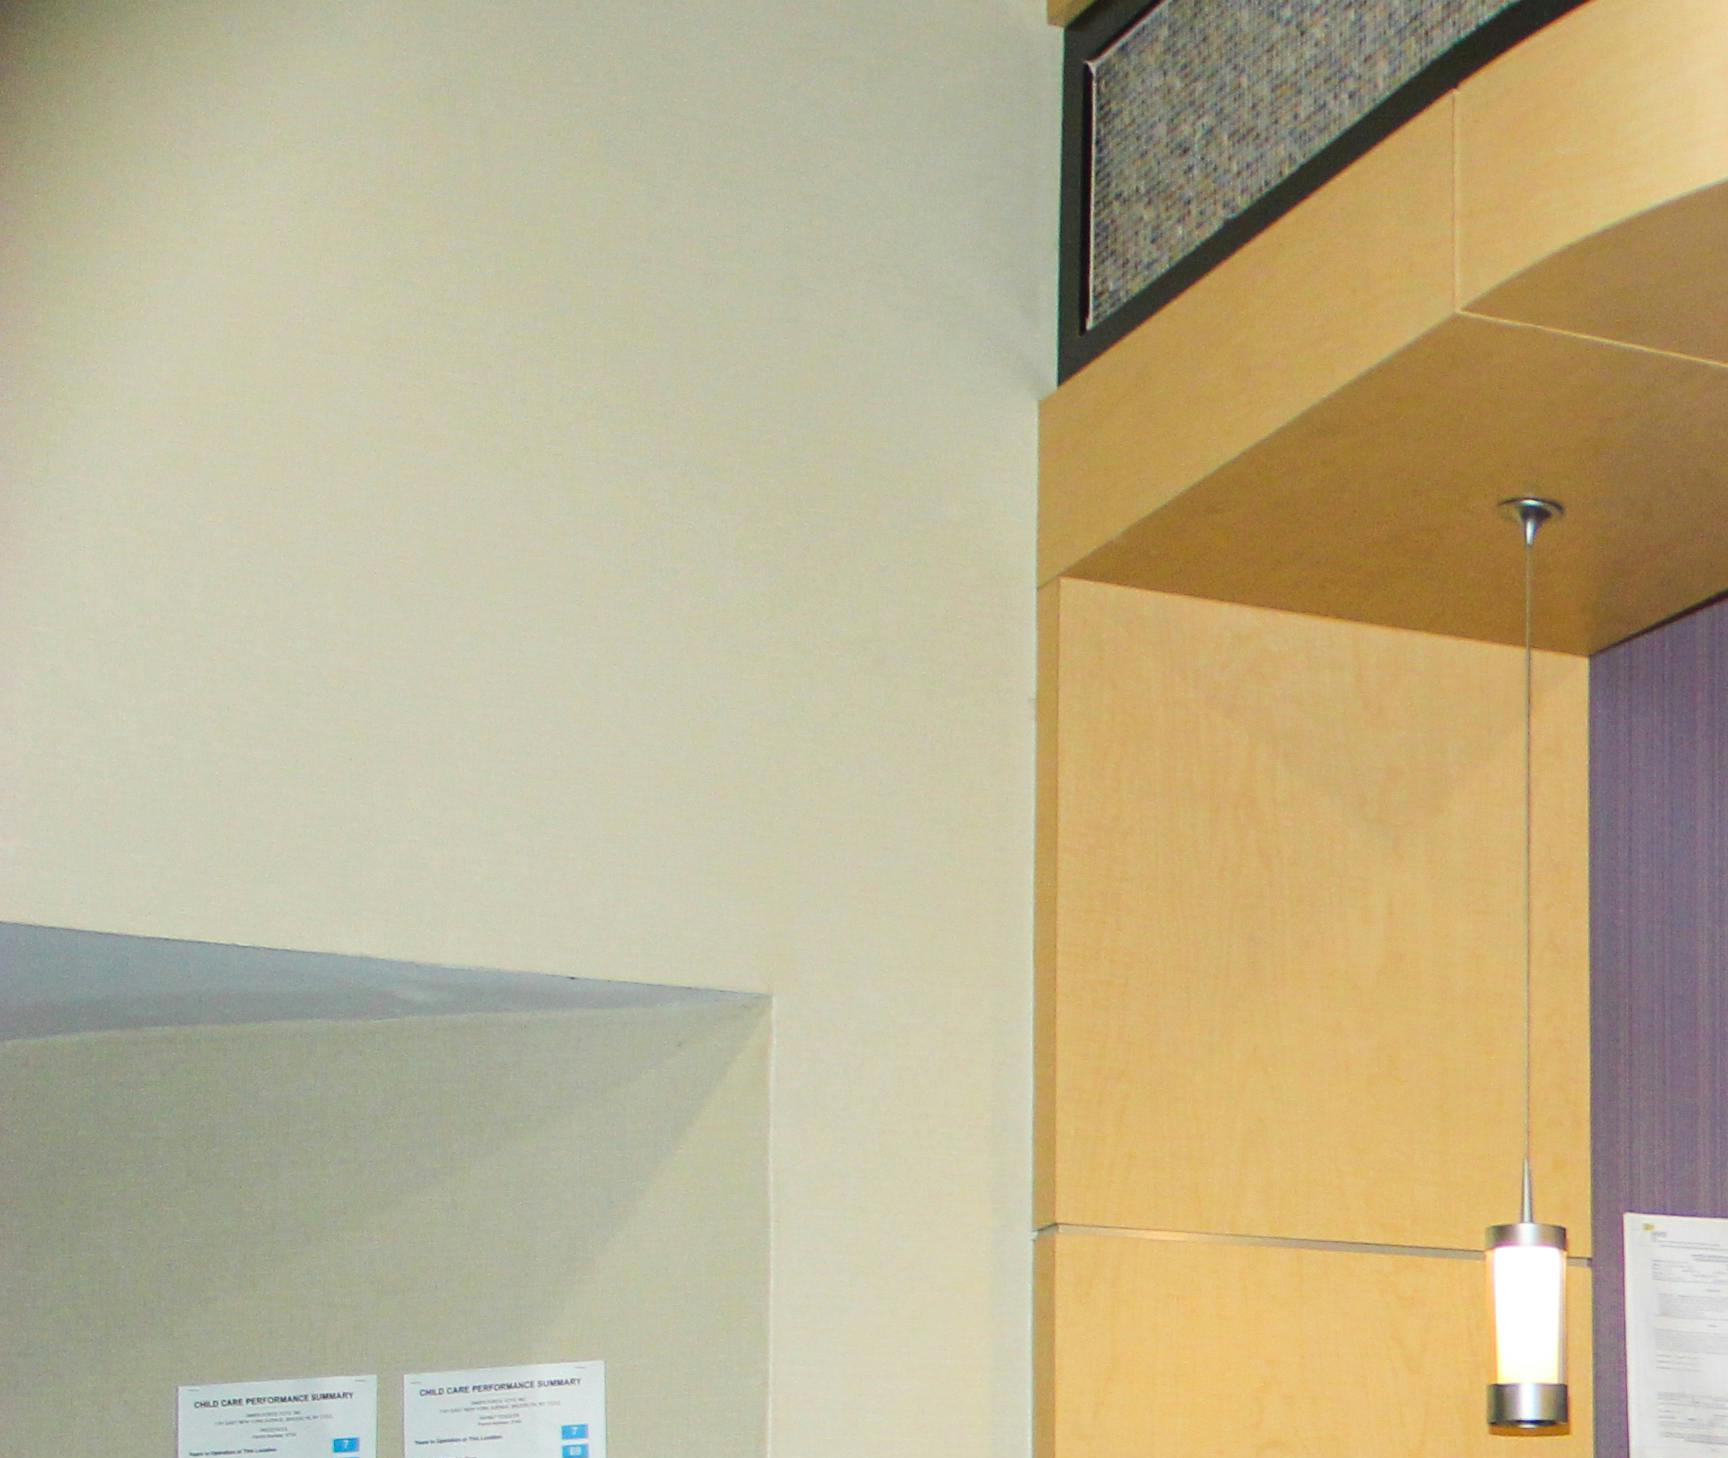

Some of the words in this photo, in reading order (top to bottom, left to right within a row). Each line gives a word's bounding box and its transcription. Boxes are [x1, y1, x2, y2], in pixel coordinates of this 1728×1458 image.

[419, 1388, 445, 1397] CHILD
[447, 1386, 470, 1394] CARE
[472, 1381, 535, 1393] PERFORMANCE
[537, 1377, 582, 1387] SUMMARY
[221, 1399, 243, 1407] CARE
[245, 1394, 309, 1405] PERFORMANCE
[311, 1392, 354, 1401] SUMMARY
